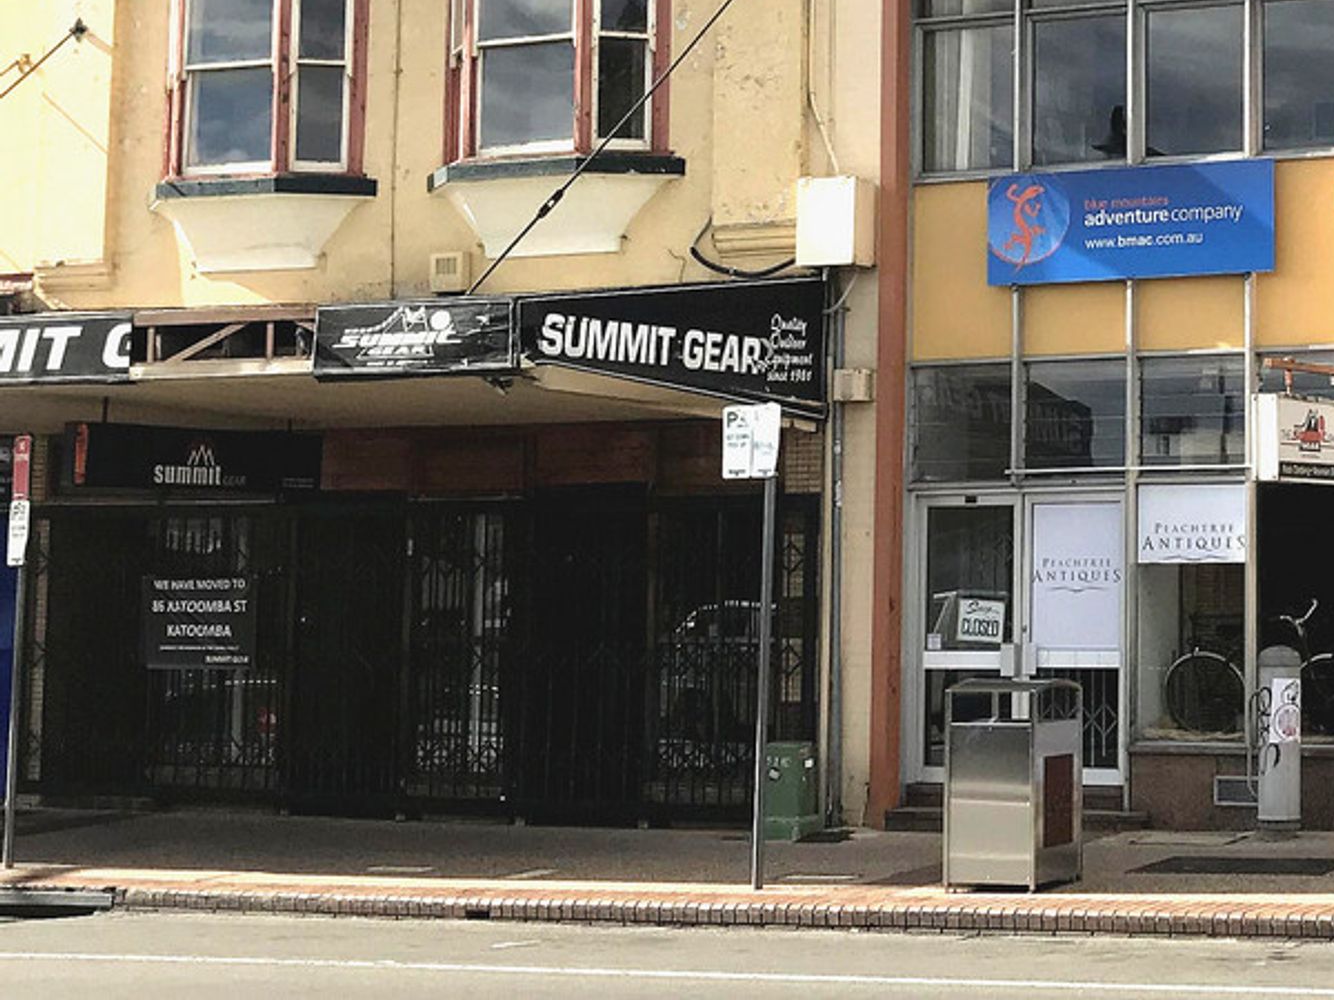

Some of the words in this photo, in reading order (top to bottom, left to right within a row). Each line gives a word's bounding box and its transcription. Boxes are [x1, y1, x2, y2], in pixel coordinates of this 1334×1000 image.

[1085, 232, 1203, 250] www.bmac.com.au
[541, 313, 676, 366] SUMMIT
[682, 328, 760, 375] GEAR
[153, 464, 222, 486] summit
[1154, 522, 1235, 534] PEACHTREE
[1142, 536, 1246, 551] ANTIQUES
[1042, 557, 1112, 568] PEACHTREE
[1032, 568, 1122, 583] ANTIQUES
[233, 600, 247, 613] ST
[962, 617, 1000, 637] CLOSED
